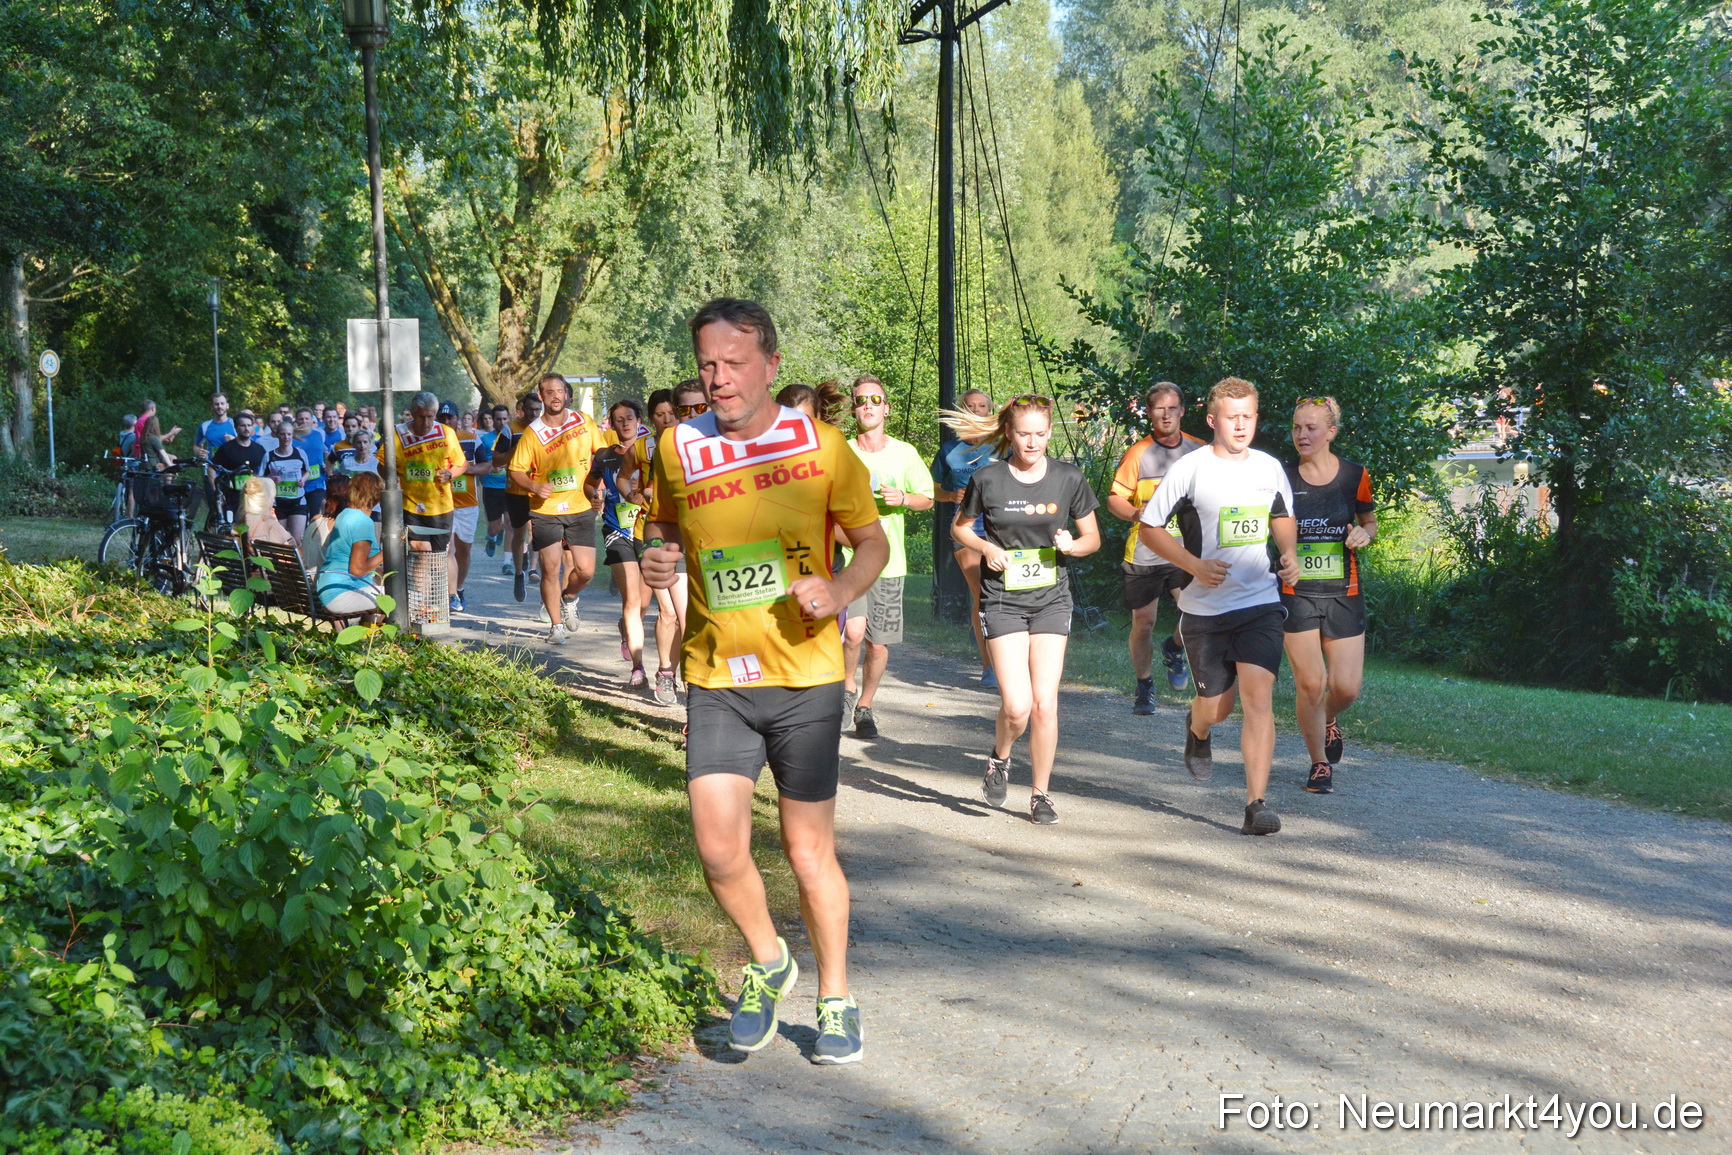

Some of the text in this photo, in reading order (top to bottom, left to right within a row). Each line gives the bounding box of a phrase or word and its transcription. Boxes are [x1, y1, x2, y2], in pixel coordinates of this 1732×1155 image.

[544, 427, 588, 455] MAX BÖGL
[403, 441, 449, 458] MAX BÖGL
[409, 469, 431, 477] 1269
[552, 475, 574, 486] 1334
[686, 460, 824, 510] MAX BÖGL
[1231, 519, 1259, 535] 763
[1296, 518, 1329, 528] HECK
[1299, 525, 1346, 535] DESIGN
[1304, 555, 1331, 569] 801
[1021, 563, 1041, 578] 32
[712, 563, 776, 594] 1322
[717, 586, 777, 601] Edenharder Stefan
